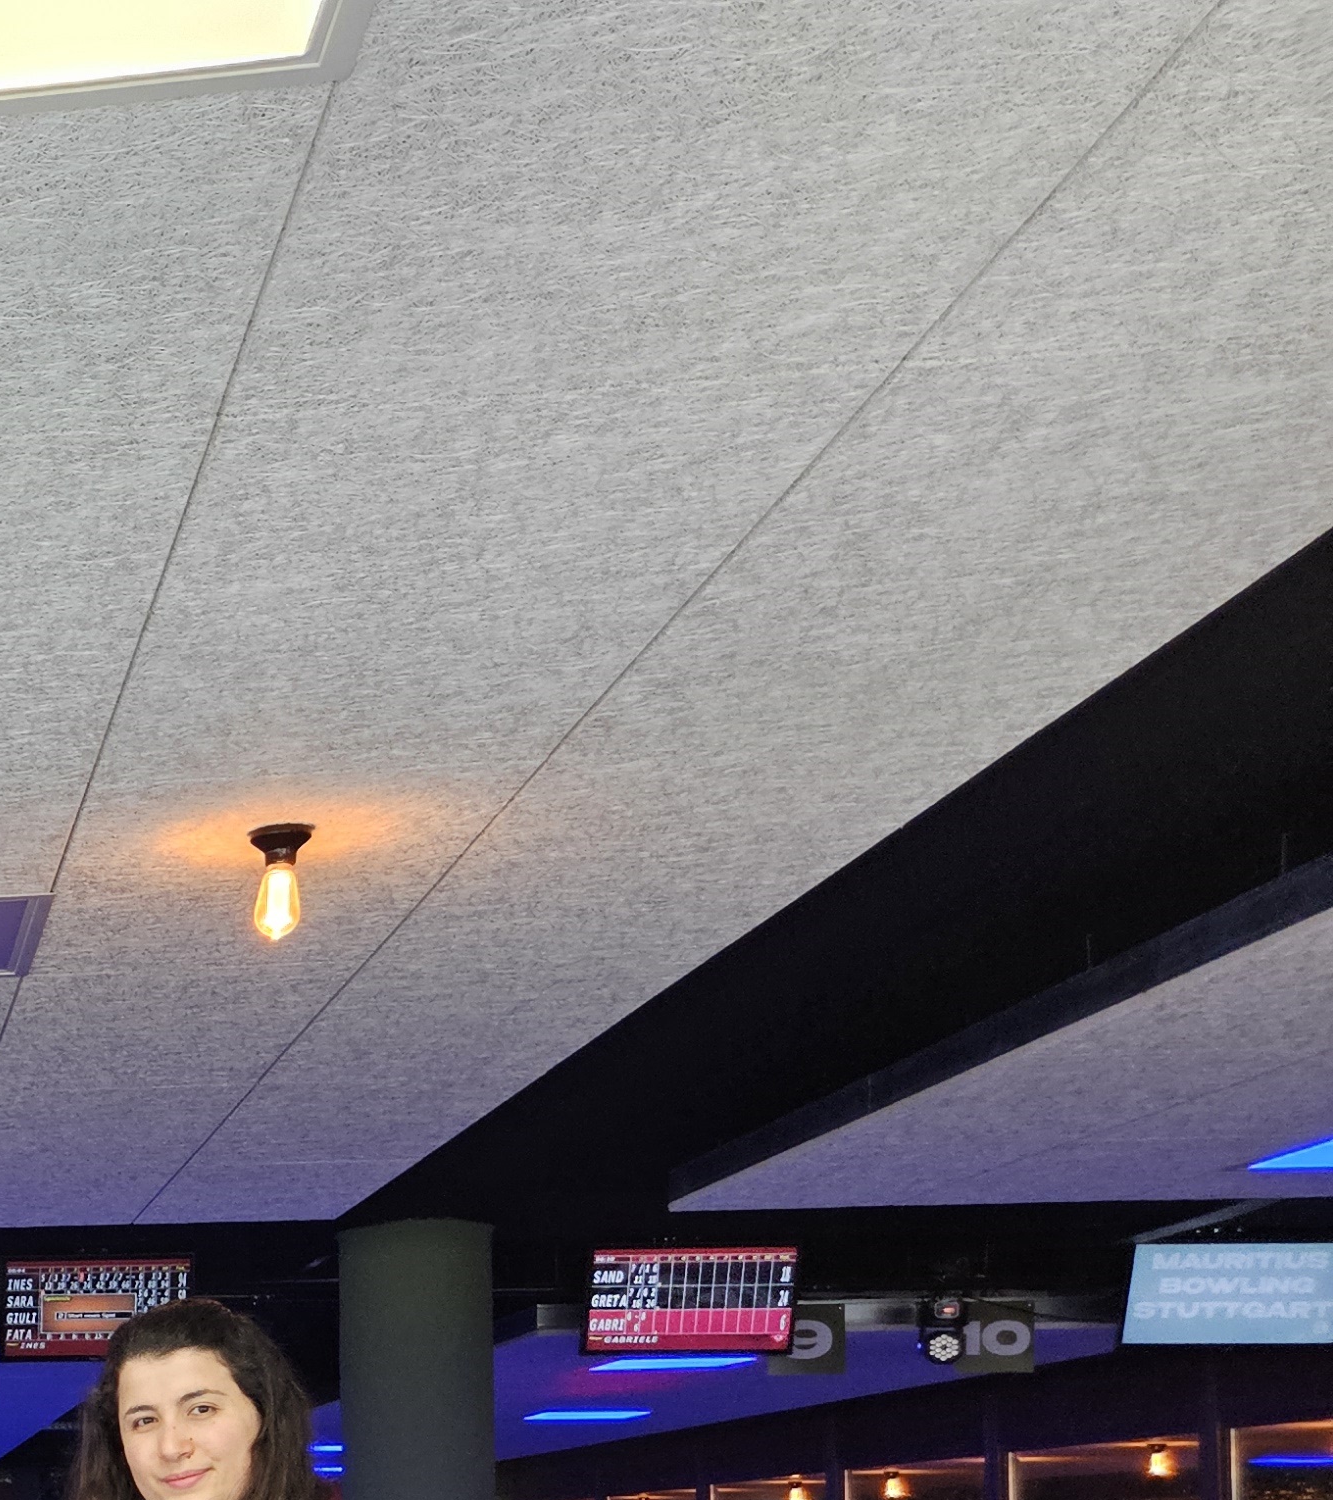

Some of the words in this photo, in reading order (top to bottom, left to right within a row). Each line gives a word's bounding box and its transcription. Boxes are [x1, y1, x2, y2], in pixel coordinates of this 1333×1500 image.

[1151, 1252, 1329, 1270] MAURITIUS
[593, 1270, 624, 1283] SAND
[7, 1278, 33, 1290] INES
[1158, 1276, 1317, 1294] BOWLING
[6, 1296, 34, 1307] SARA
[591, 1294, 627, 1307] GRETA
[1133, 1301, 1333, 1319] STUTTGART
[6, 1312, 37, 1324] GIULI
[589, 1318, 625, 1331] GABRI
[6, 1329, 32, 1340] FATA
[786, 1319, 833, 1359] 9
[962, 1319, 1031, 1356] 10
